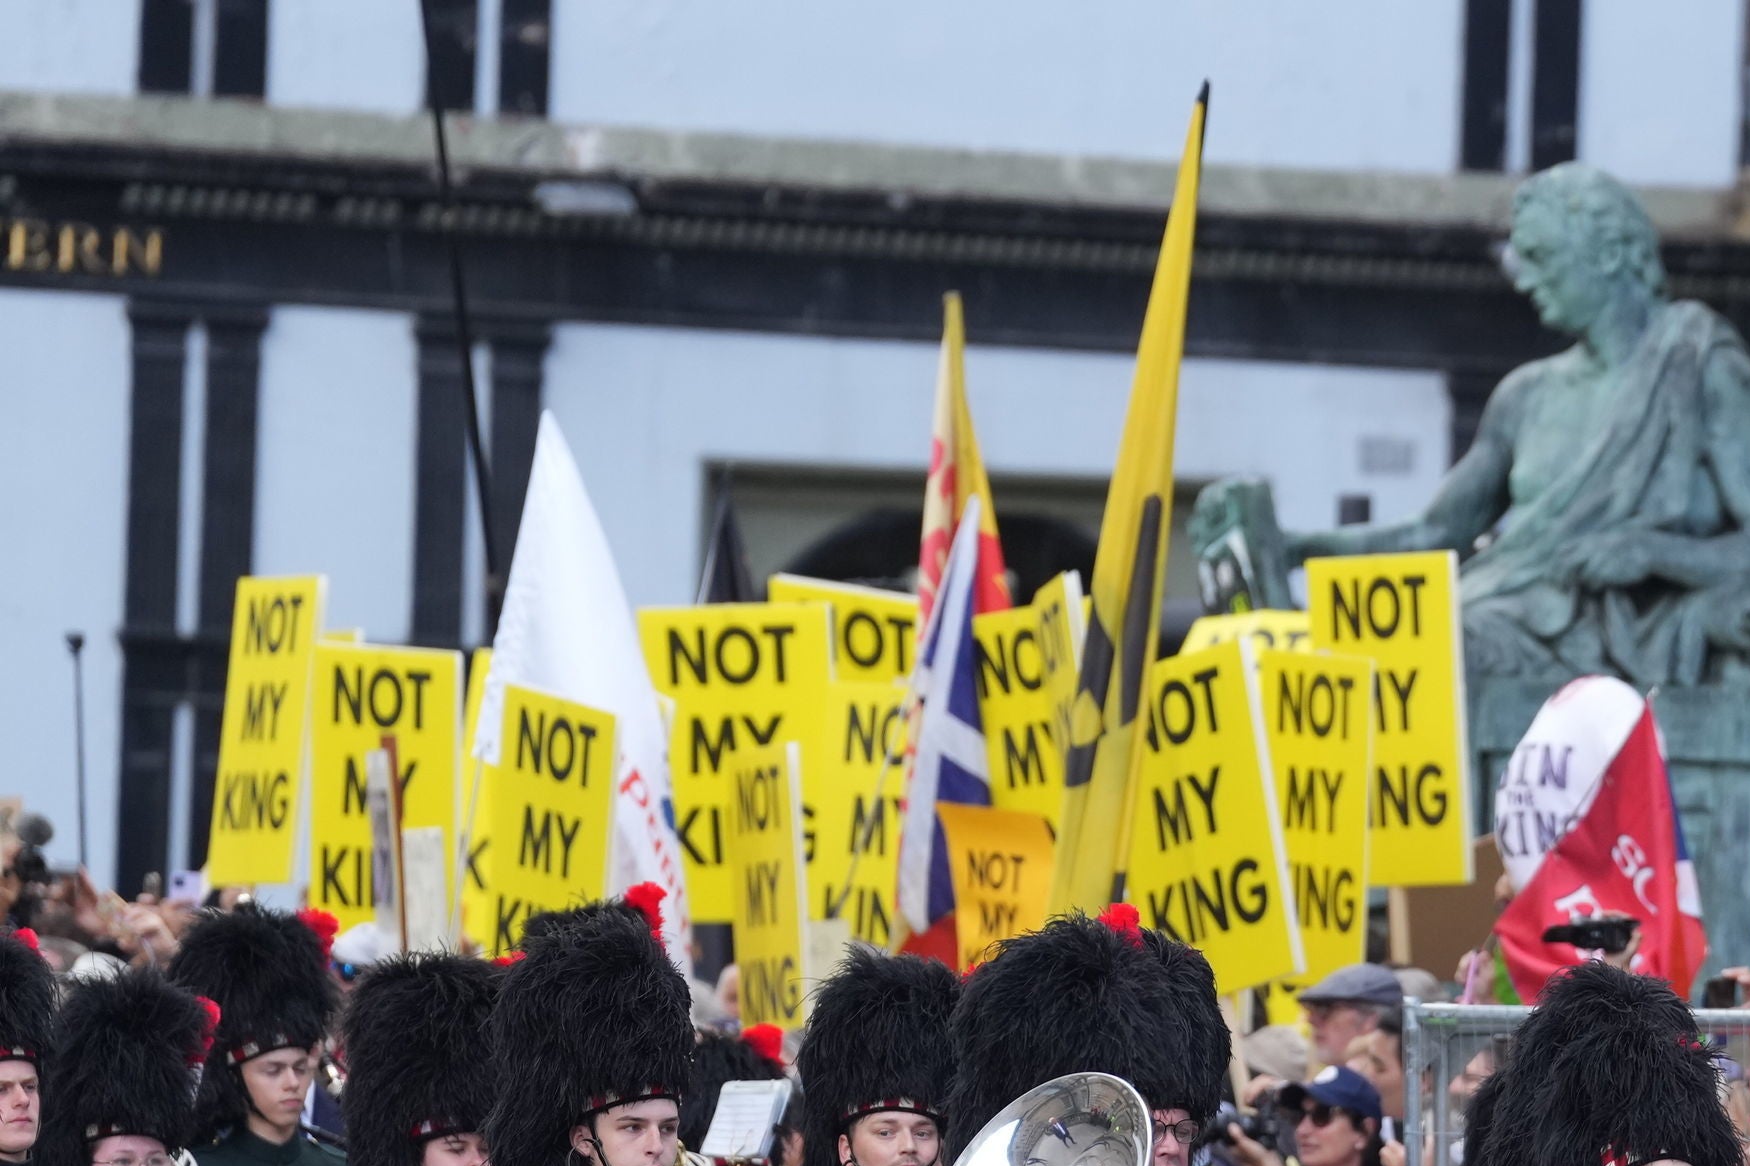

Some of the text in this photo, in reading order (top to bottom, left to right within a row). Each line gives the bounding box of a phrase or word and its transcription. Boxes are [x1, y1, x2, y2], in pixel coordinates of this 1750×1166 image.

[245, 594, 302, 655] NOT
[1331, 576, 1426, 641] NOT
[667, 625, 794, 686] NOT
[831, 610, 914, 674] OT
[974, 630, 1041, 698] NO
[242, 682, 288, 743] MY
[333, 665, 430, 731] NOT
[1278, 669, 1355, 740] NOT
[516, 706, 597, 788] NOT
[691, 713, 782, 776] MY
[845, 704, 904, 765] NO
[1004, 722, 1056, 789] M
[219, 772, 289, 832] KING
[736, 765, 782, 836] NOT
[849, 797, 902, 857] M
[1153, 766, 1221, 852] MY
[1286, 766, 1344, 833] MY
[1368, 765, 1448, 828] NG
[519, 804, 581, 879] MY
[967, 850, 1024, 891] NOT
[745, 859, 782, 928] MY
[1148, 858, 1268, 943] KING
[1292, 863, 1355, 933] ING
[742, 956, 799, 1028] KING
